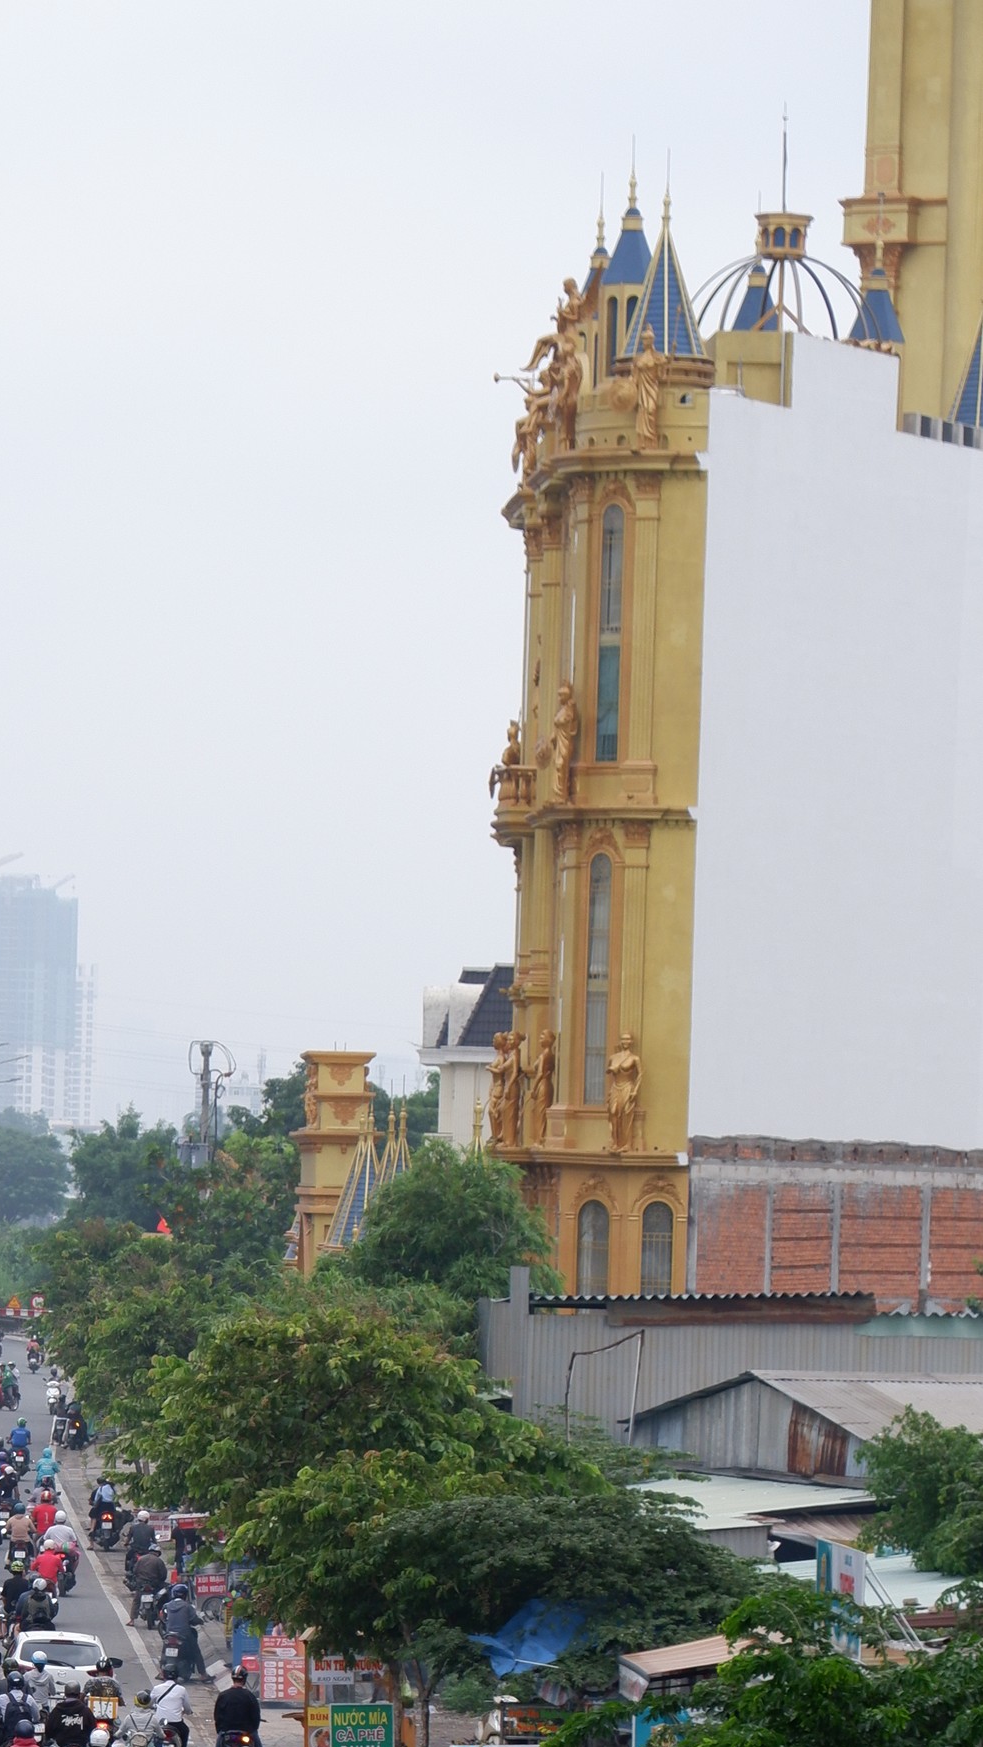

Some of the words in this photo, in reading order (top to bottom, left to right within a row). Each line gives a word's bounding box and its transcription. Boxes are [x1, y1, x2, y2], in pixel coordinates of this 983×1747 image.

[334, 1709, 366, 1726] NƯỚC
[369, 1707, 388, 1725] MÍA
[336, 1726, 357, 1742] CÀ
[358, 1725, 386, 1742] PHÊ
